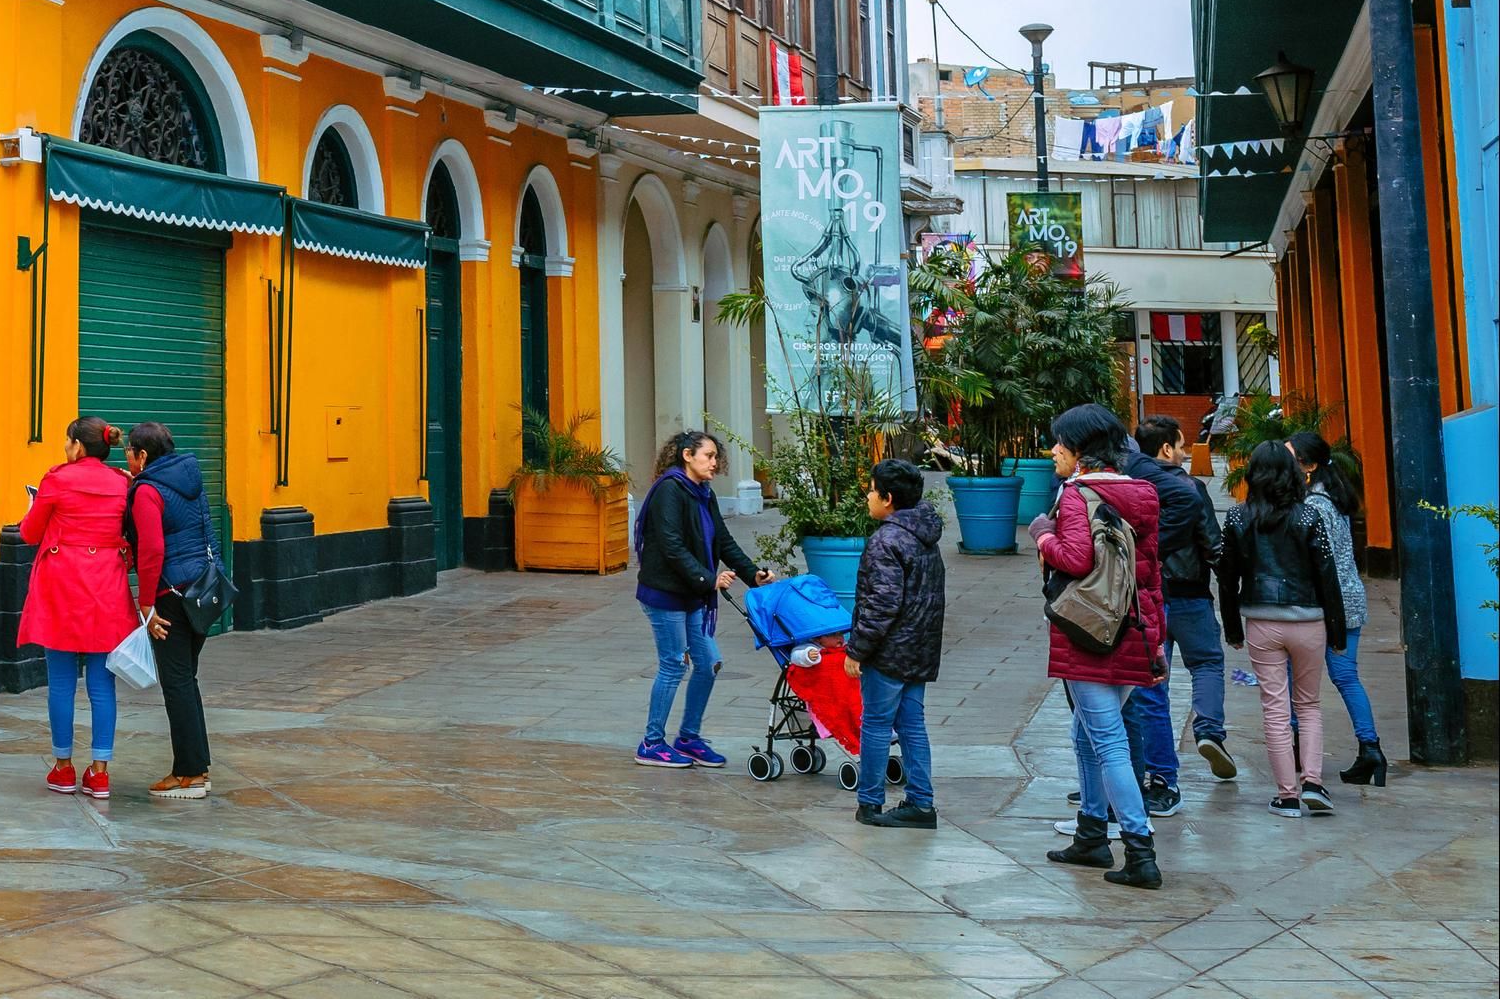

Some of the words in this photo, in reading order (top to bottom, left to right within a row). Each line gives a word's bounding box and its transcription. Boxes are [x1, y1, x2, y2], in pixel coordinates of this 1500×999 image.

[774, 136, 845, 169] ART.
[797, 168, 873, 200] MO.
[842, 201, 887, 233] 19
[1016, 207, 1055, 225] ART.
[1029, 224, 1070, 241] MO.
[1053, 240, 1078, 258] 19
